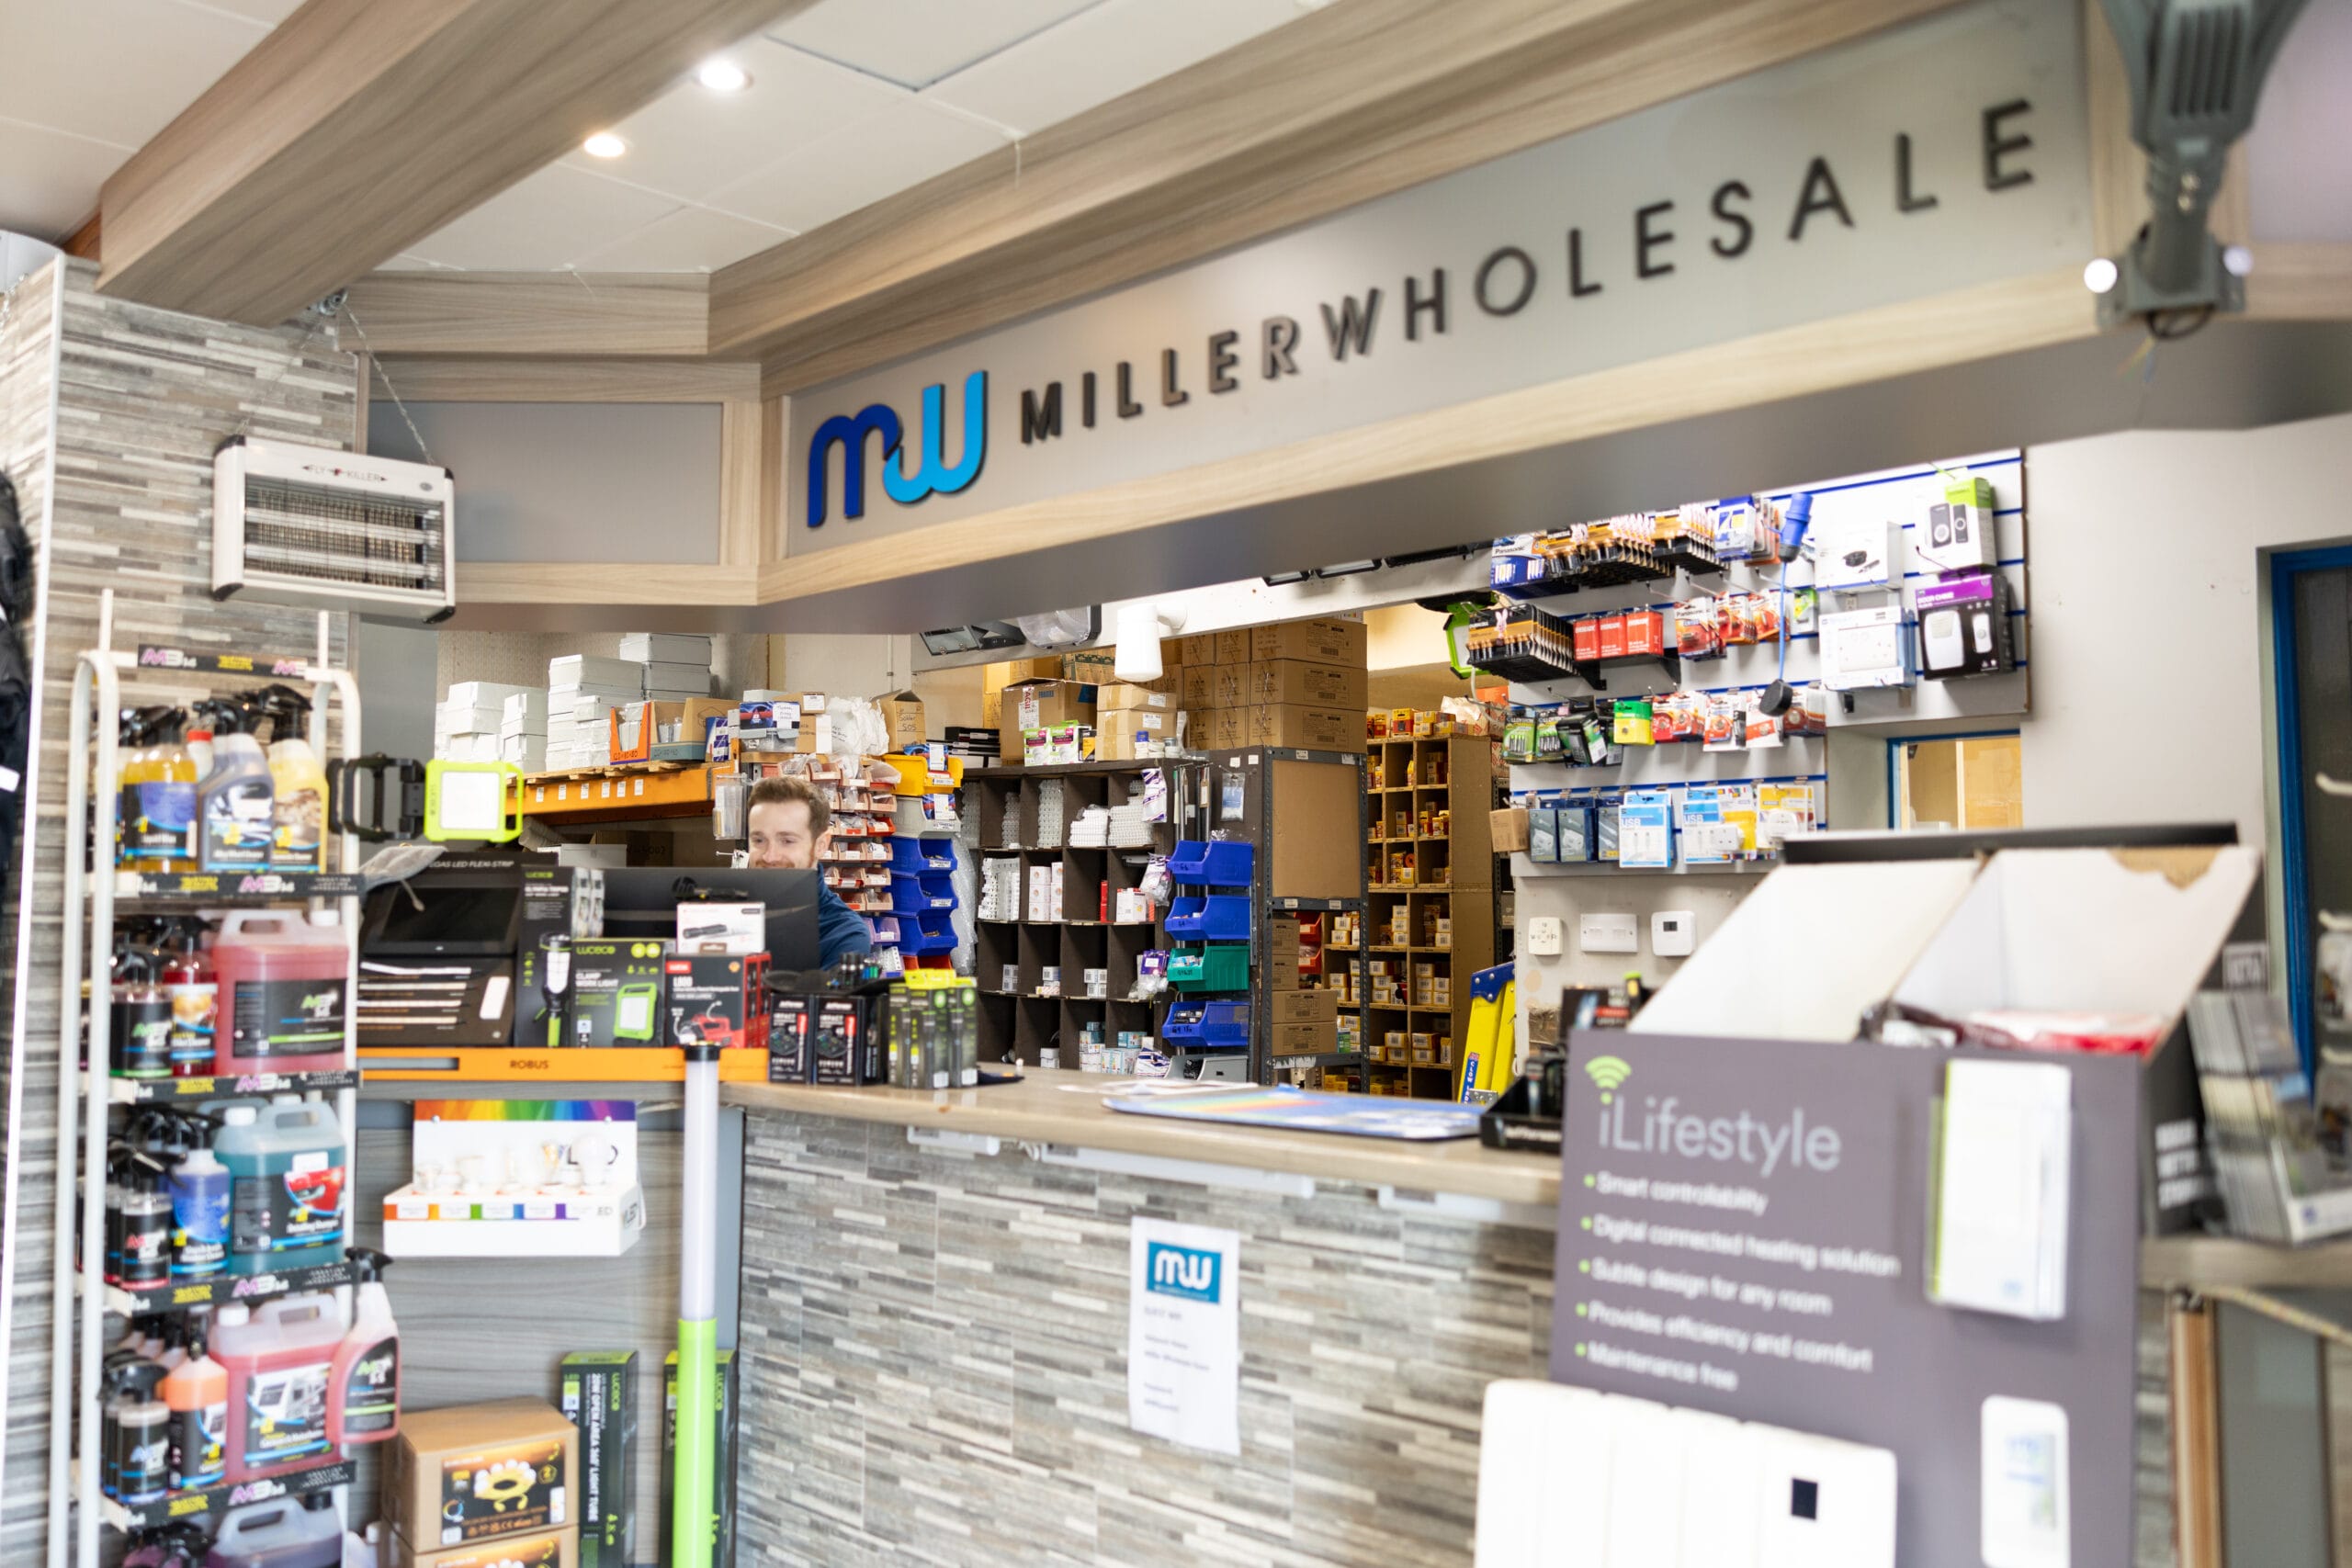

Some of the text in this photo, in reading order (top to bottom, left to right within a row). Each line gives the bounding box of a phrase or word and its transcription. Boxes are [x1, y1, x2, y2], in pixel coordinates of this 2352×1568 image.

[310, 464, 380, 481] FLY KILLER
[1495, 546, 1526, 555] Panasonic
[1677, 607, 1706, 617] Panasonic
[1621, 818, 1641, 828] USB
[1683, 814, 1703, 823] USB
[576, 945, 616, 955] LUCECO
[510, 1060, 549, 1070] ROBUS
[1599, 1091, 1842, 1179] iLifestyle
[1596, 1170, 1649, 1199] Smart
[1592, 1213, 1902, 1277] Digital connected heating solution
[1590, 1257, 1834, 1317] Subtle design for any room
[1588, 1300, 1874, 1372] Provides efficiency and comfort
[1588, 1340, 1738, 1392] Maintenance free
[610, 1372, 620, 1411] LUCECO
[591, 1394, 601, 1421] OPEN
[590, 1421, 600, 1447] AREA
[589, 1467, 599, 1495] LIGHT
[588, 1495, 599, 1522] TUBE
